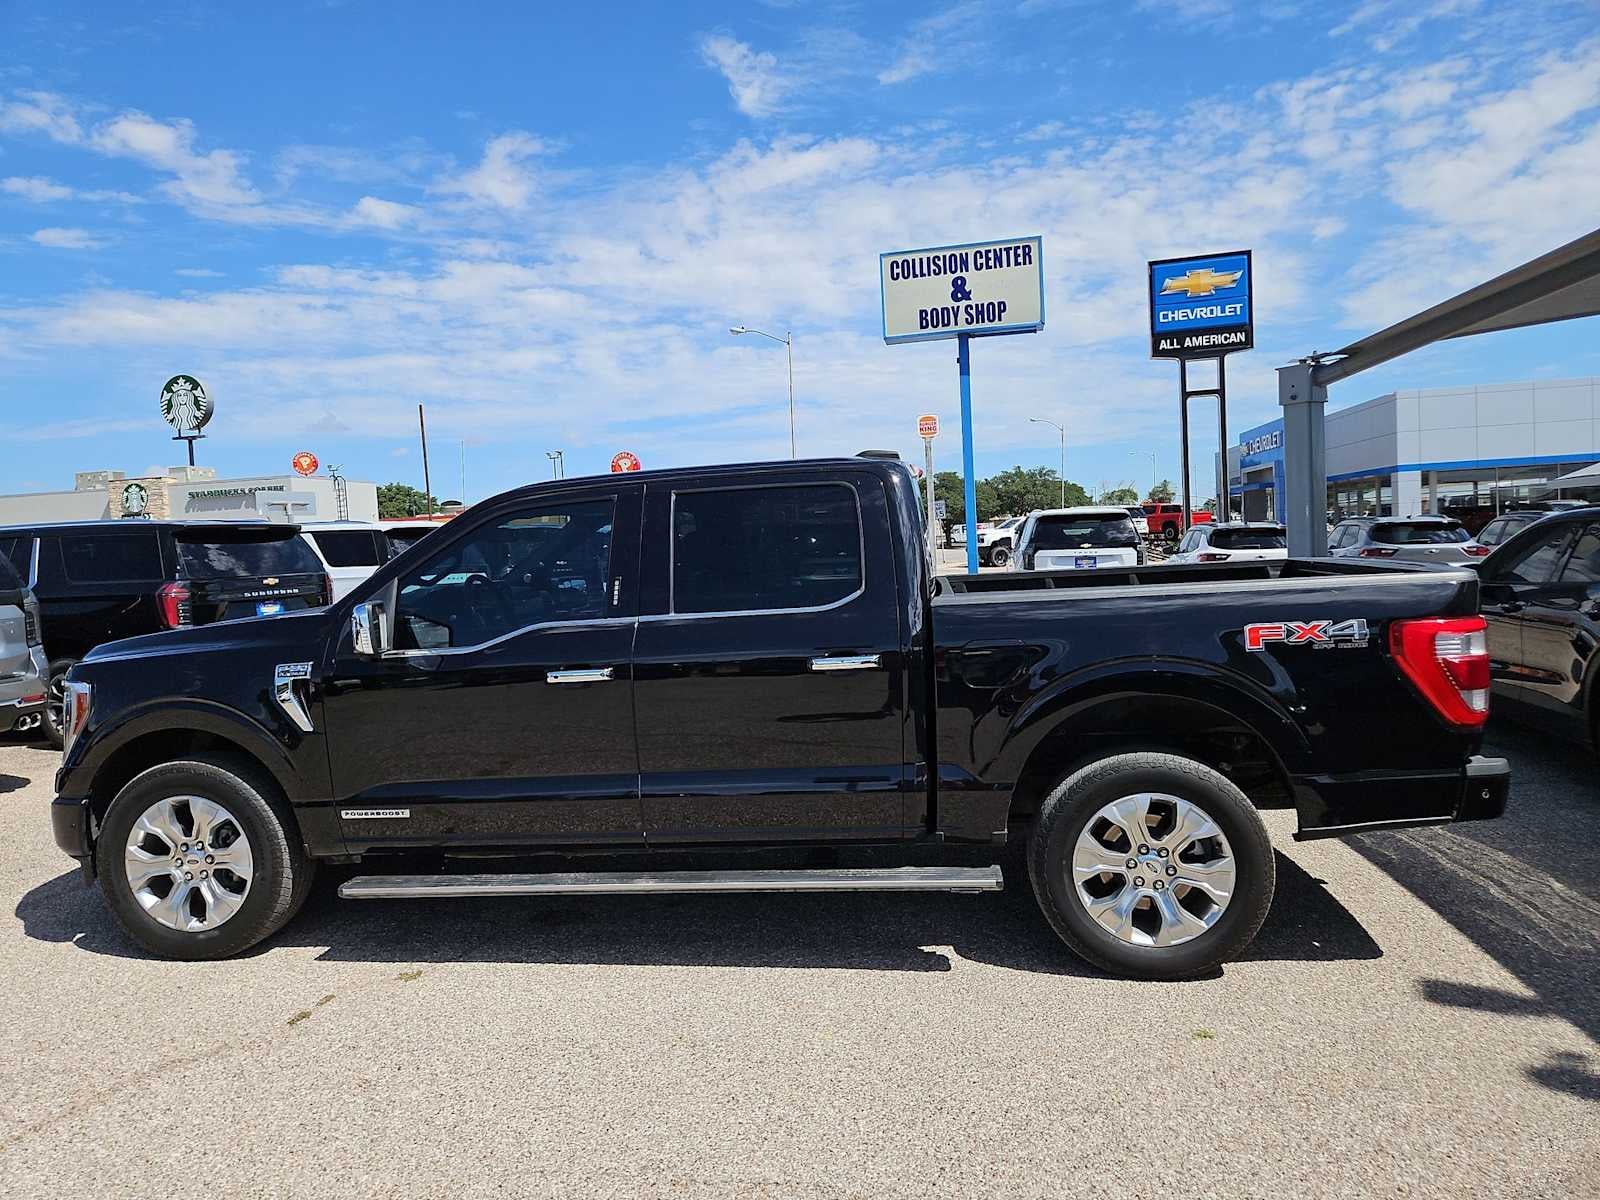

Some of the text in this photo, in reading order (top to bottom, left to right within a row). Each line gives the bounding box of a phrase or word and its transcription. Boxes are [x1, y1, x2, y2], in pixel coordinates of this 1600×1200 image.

[890, 244, 1033, 281] COLLISION CENTER
[950, 275, 972, 303] &
[919, 300, 1007, 330] BODY SHOP
[1159, 303, 1244, 323] CHEVROLET
[1159, 331, 1246, 350] ALL AMERICAN
[1249, 431, 1281, 455] CHEVROLET
[1244, 618, 1370, 652] FX4
